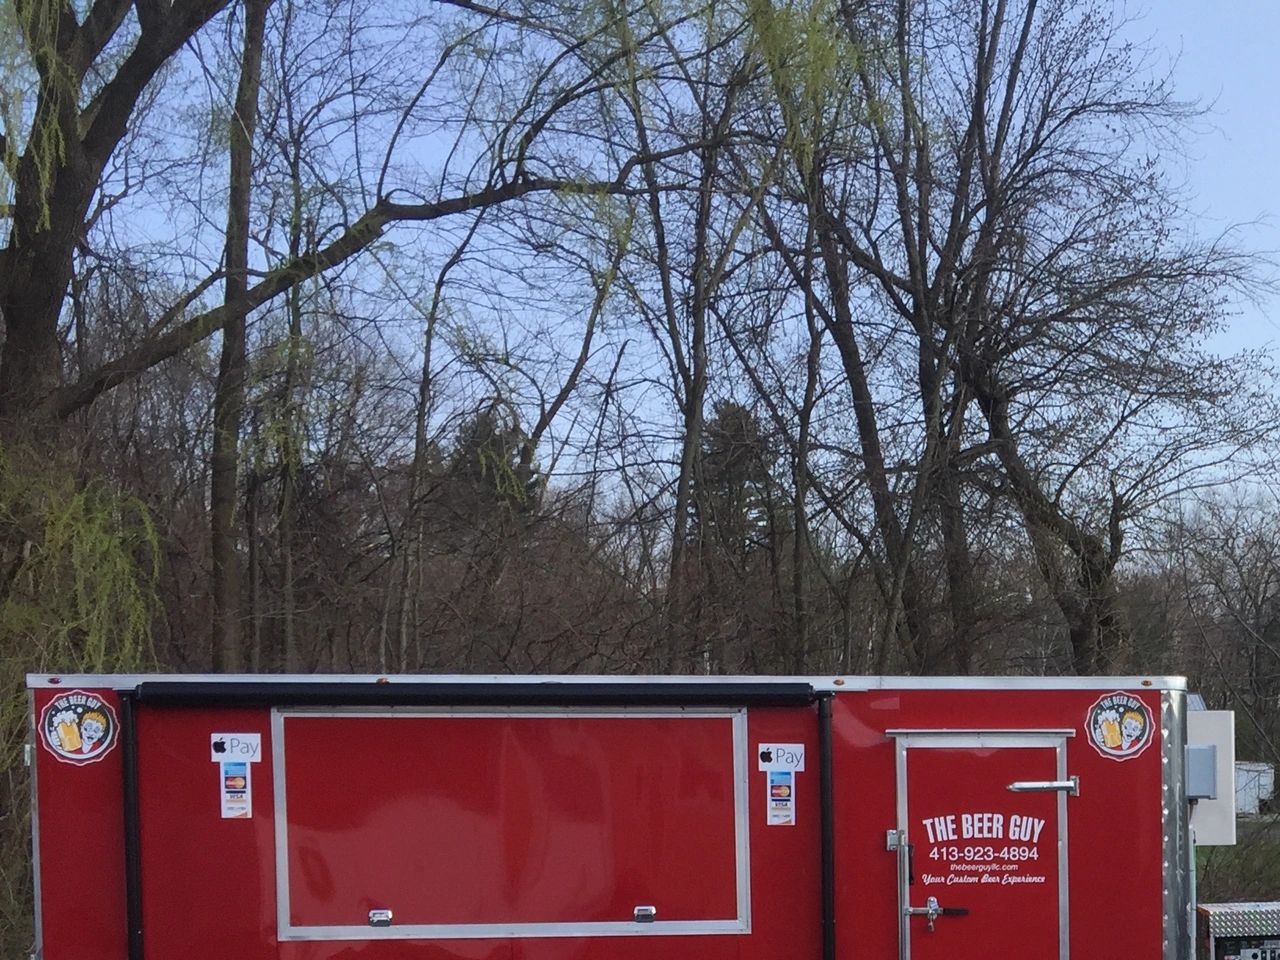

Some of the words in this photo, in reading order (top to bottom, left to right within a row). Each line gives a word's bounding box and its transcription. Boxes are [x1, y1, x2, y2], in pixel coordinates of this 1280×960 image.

[54, 697, 69, 710] THE
[68, 695, 86, 705] BEER
[86, 697, 102, 710] GUY
[1100, 697, 1113, 710] THE
[1112, 695, 1128, 705] BEER
[1127, 697, 1141, 710] GUY
[230, 737, 259, 758] Pay
[776, 747, 803, 768] Pay
[922, 815, 958, 844] THE
[961, 813, 1004, 839] BEER
[1008, 814, 1046, 843] GUY
[929, 846, 1039, 861] 413-923-4894
[950, 863, 1019, 872] thebeerguyllc.com
[922, 873, 945, 885] Your
[946, 873, 979, 885] Custom
[980, 873, 1000, 884] Beer
[1001, 873, 1046, 885] Experience
